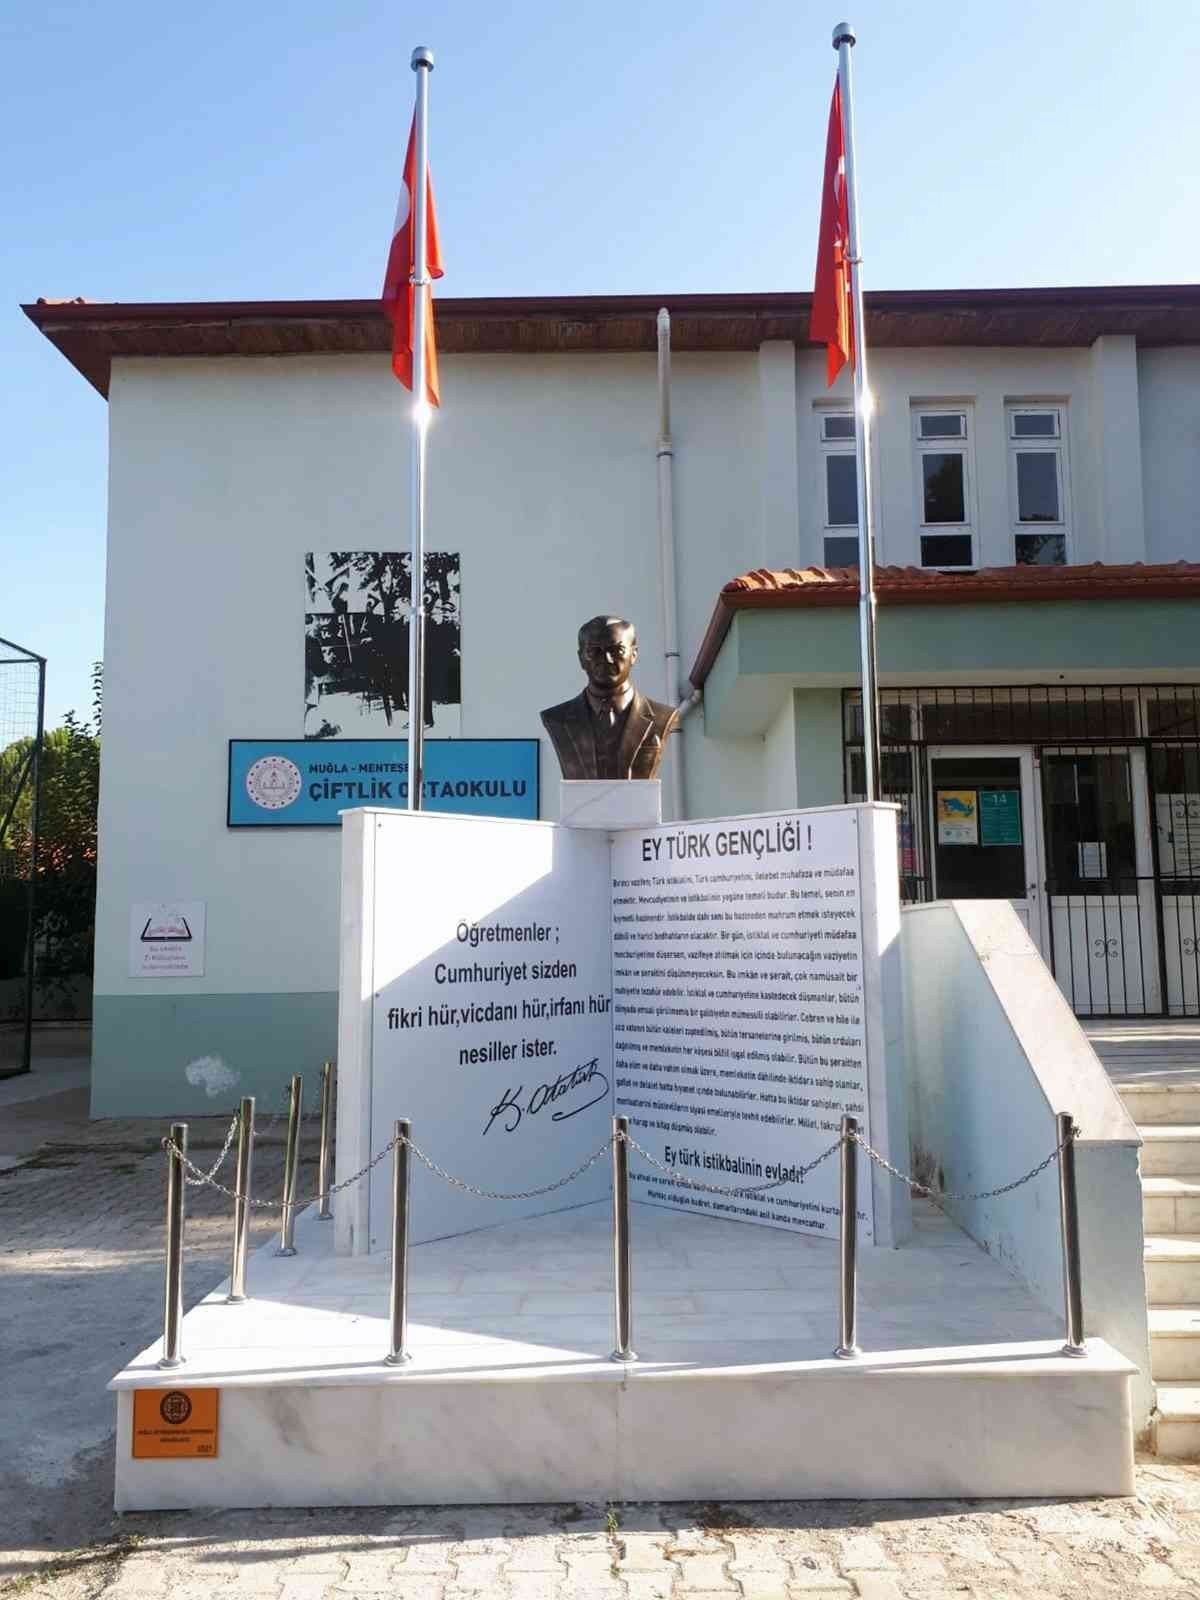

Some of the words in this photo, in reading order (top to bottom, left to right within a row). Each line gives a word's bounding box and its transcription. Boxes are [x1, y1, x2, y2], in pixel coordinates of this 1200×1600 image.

[309, 778, 392, 801] ÇİFTLİK
[399, 780, 526, 798] OTAOKULU
[642, 838, 662, 861] EY
[666, 831, 711, 860] TÜRK
[715, 820, 801, 860] GENÇLİĞİ
[790, 890, 799, 899] Bu
[846, 889, 854, 897] en
[725, 912, 732, 920] bu
[798, 910, 819, 919] etmek
[456, 919, 551, 947] Öğretmenler
[720, 931, 730, 940] Bir
[771, 932, 778, 940] ve
[824, 930, 856, 939] müdafaa
[434, 961, 527, 986] Cumhuriyet
[531, 960, 577, 979] sizden
[726, 970, 736, 979] Bu
[794, 972, 807, 982] çok
[846, 972, 857, 982] bir
[838, 993, 858, 1003] bütün
[387, 1006, 422, 1030] fikri
[589, 995, 611, 1013] hür
[811, 1034, 830, 1044] bütün
[459, 1040, 517, 1065] nesiller
[521, 1039, 557, 1058] ister.
[798, 1054, 817, 1064] Bütün
[820, 1055, 828, 1065] bu
[778, 1093, 786, 1103] bu
[664, 1146, 677, 1166] Ey
[679, 1148, 700, 1168] türk
[703, 1152, 762, 1177] istikbalinin
